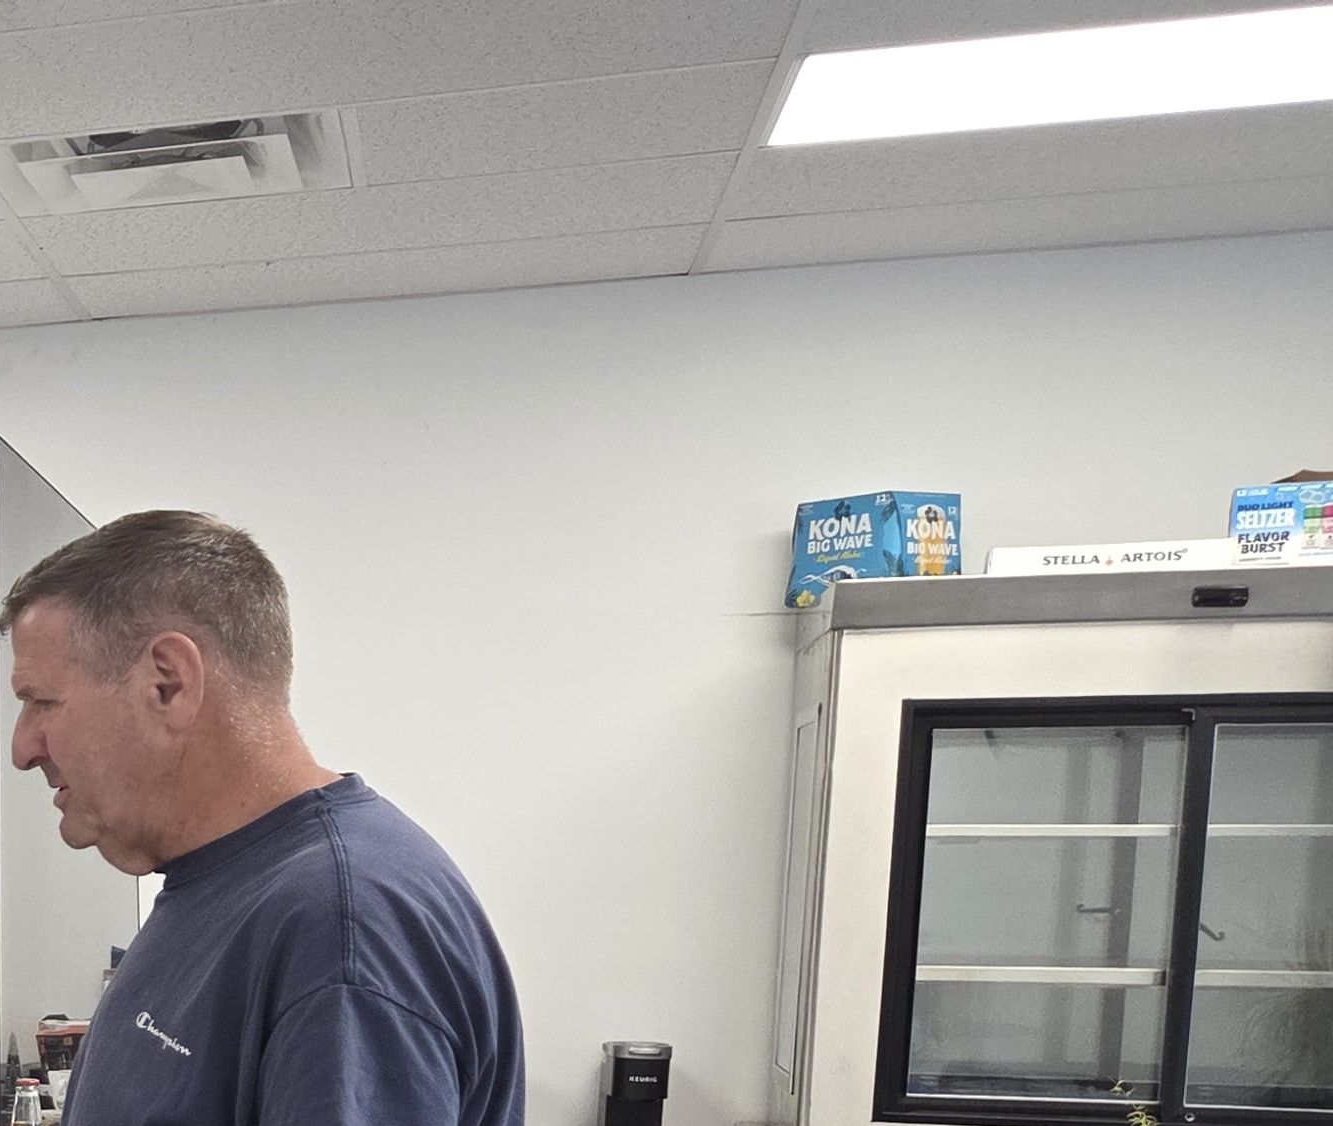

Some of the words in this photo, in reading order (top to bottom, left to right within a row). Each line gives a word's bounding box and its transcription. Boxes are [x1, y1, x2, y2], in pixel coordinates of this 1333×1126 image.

[1261, 501, 1294, 510] LIGHT
[1236, 508, 1295, 529] SELTZER
[808, 513, 872, 541] KONA
[906, 518, 956, 540] KONA
[807, 540, 830, 555] BIG
[834, 534, 873, 551] WAVE
[1238, 531, 1290, 544] FLAVOR
[906, 541, 925, 555] BIG
[927, 542, 959, 556] WAVE
[1241, 542, 1285, 554] BURST
[1043, 555, 1100, 566] STELLA
[1121, 550, 1183, 563] ARTOIS
